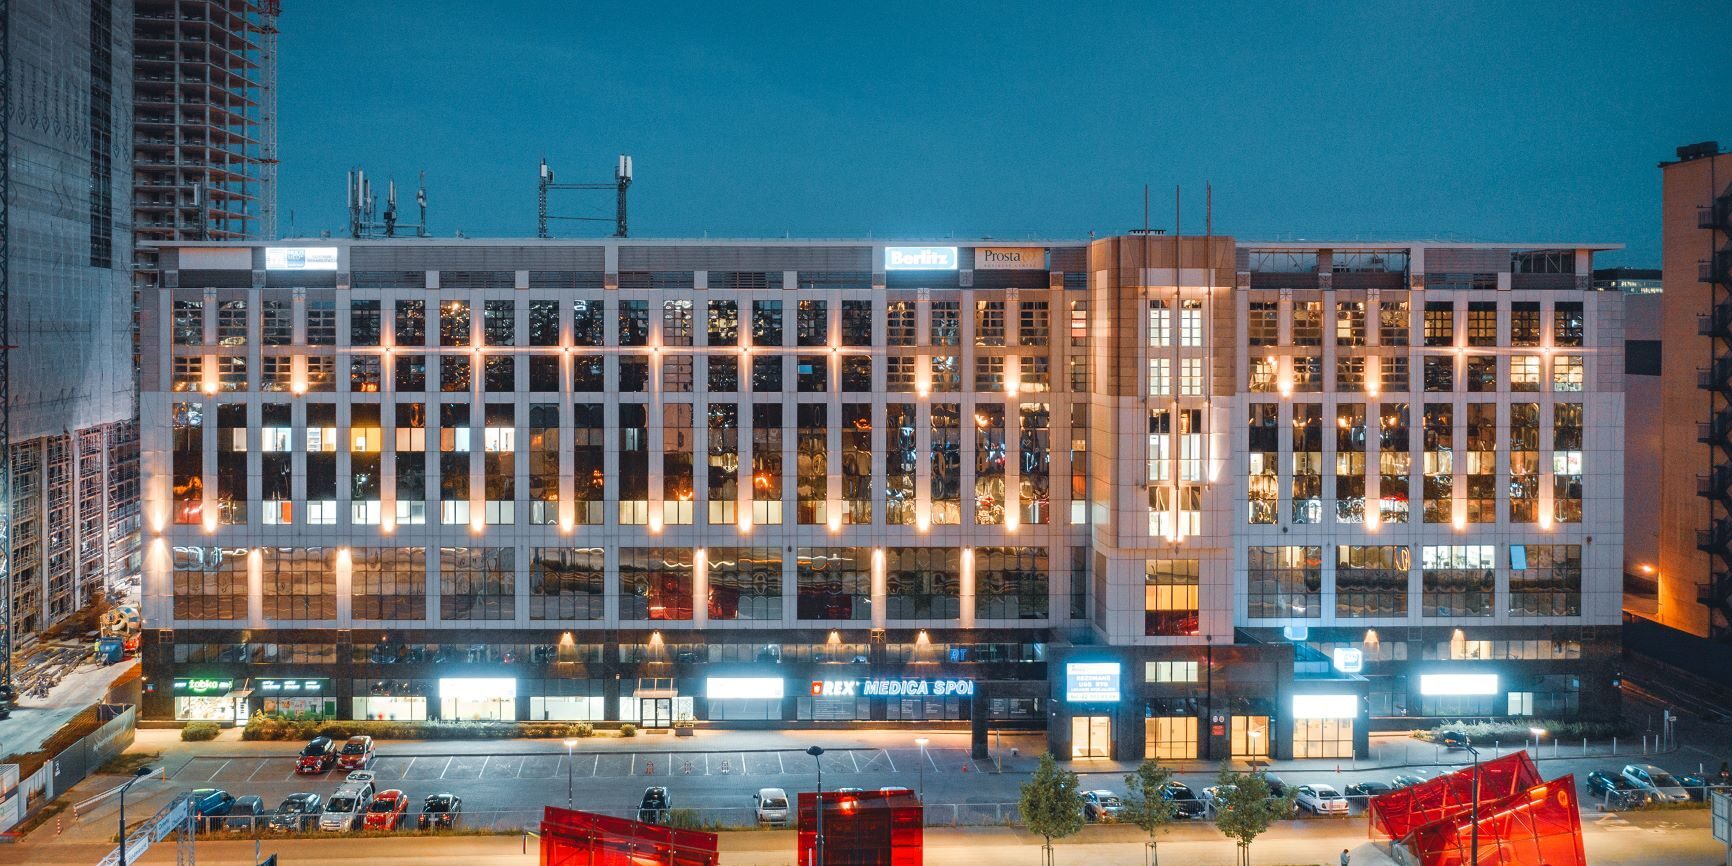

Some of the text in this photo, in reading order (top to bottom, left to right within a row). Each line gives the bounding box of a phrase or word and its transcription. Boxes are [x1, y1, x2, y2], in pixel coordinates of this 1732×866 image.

[891, 249, 948, 265] Berlitz
[984, 249, 1021, 262] Prosta
[864, 680, 929, 695] MEDICA
